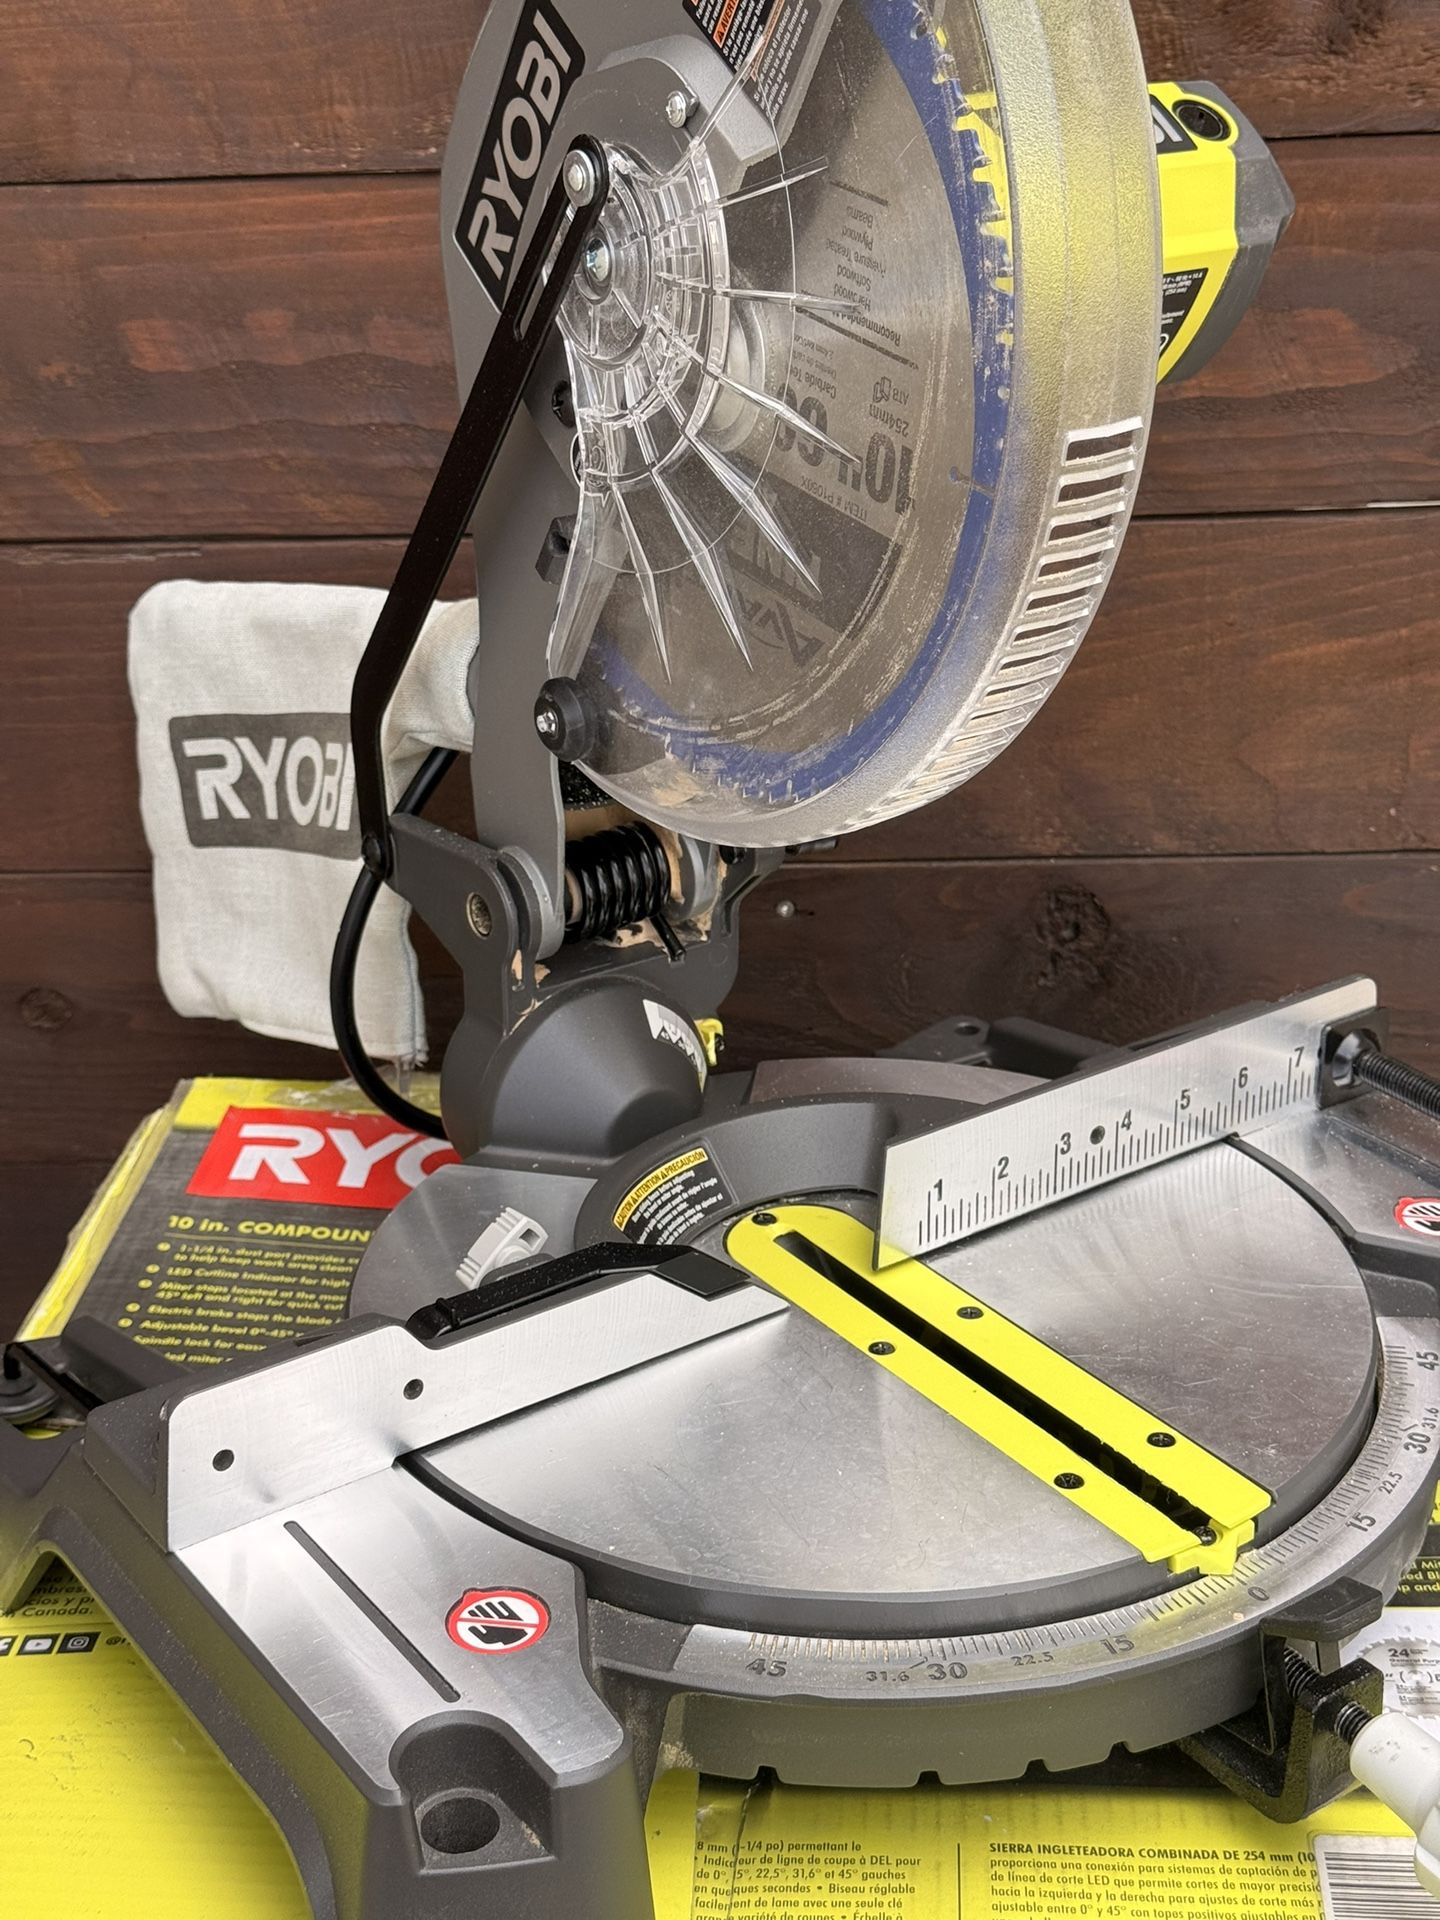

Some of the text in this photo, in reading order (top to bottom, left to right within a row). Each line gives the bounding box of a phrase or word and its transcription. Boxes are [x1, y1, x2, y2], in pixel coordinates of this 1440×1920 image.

[467, 11, 571, 281] RYOBI
[870, 403, 911, 438] 254mm
[182, 736, 356, 831] RYOBI
[934, 1046, 1305, 1200] 1 2 3 4 5 6 7
[634, 1174, 662, 1200] ATTENTION
[168, 1215, 372, 1242] 10 in. COMPOUN
[167, 1266, 193, 1276] LED
[140, 1320, 248, 1335] Adjustable bevel
[184, 1338, 212, 1348] lock
[213, 1339, 234, 1350] for
[746, 1350, 1440, 1684] 45 31.6 30 22.5 15 0 15 22.5 30 31.6 45
[22, 1606, 94, 1618] Canada.
[1388, 1648, 1410, 1658] 24
[696, 1840, 862, 1853] 8 mm po) permettant le
[989, 1842, 1294, 1862] SIERRA INGLETEADORA COMBINADA DE 254 mm
[760, 1854, 922, 1868] de ligne de coupe à DEL pour
[990, 1858, 1057, 1870] proporciona
[1060, 1861, 1082, 1870] una
[1086, 1861, 1134, 1872] conexión
[1138, 1864, 1164, 1874] para
[1168, 1864, 1216, 1874] sistemas
[1219, 1864, 1232, 1875] de
[1236, 1866, 1289, 1877] captación
[1292, 1866, 1306, 1877] de
[696, 1868, 710, 1879] de
[792, 1868, 822, 1880] 31,6°
[824, 1870, 835, 1879] et
[838, 1868, 858, 1879] 45°
[862, 1868, 906, 1881] gauches
[990, 1870, 1276, 1893] de línea de corte LED que permite cortes de mayor
[694, 1882, 916, 1896] en secondes Biseau réglable
[991, 1885, 1021, 1897] hacia
[1024, 1886, 1035, 1898] la
[1038, 1887, 1092, 1900] izquierda
[1096, 1892, 1102, 1902] y
[1106, 1890, 1116, 1901] la
[1120, 1890, 1165, 1903] derecha
[1168, 1894, 1196, 1905] para
[1199, 1894, 1238, 1906] ajustes
[1242, 1894, 1256, 1906] de
[1260, 1897, 1288, 1907] corte
[1291, 1897, 1314, 1908] más
[754, 1897, 903, 1908] de lame avec une seule clé
[992, 1900, 1044, 1914] ajustable
[1047, 1904, 1077, 1914] entre
[1080, 1904, 1094, 1915] 0°
[1096, 1907, 1104, 1918] y
[1106, 1905, 1127, 1916] 45°
[1130, 1908, 1150, 1918] con
[1154, 1908, 1184, 1920] topes
[1188, 1909, 1238, 1920] positivos
